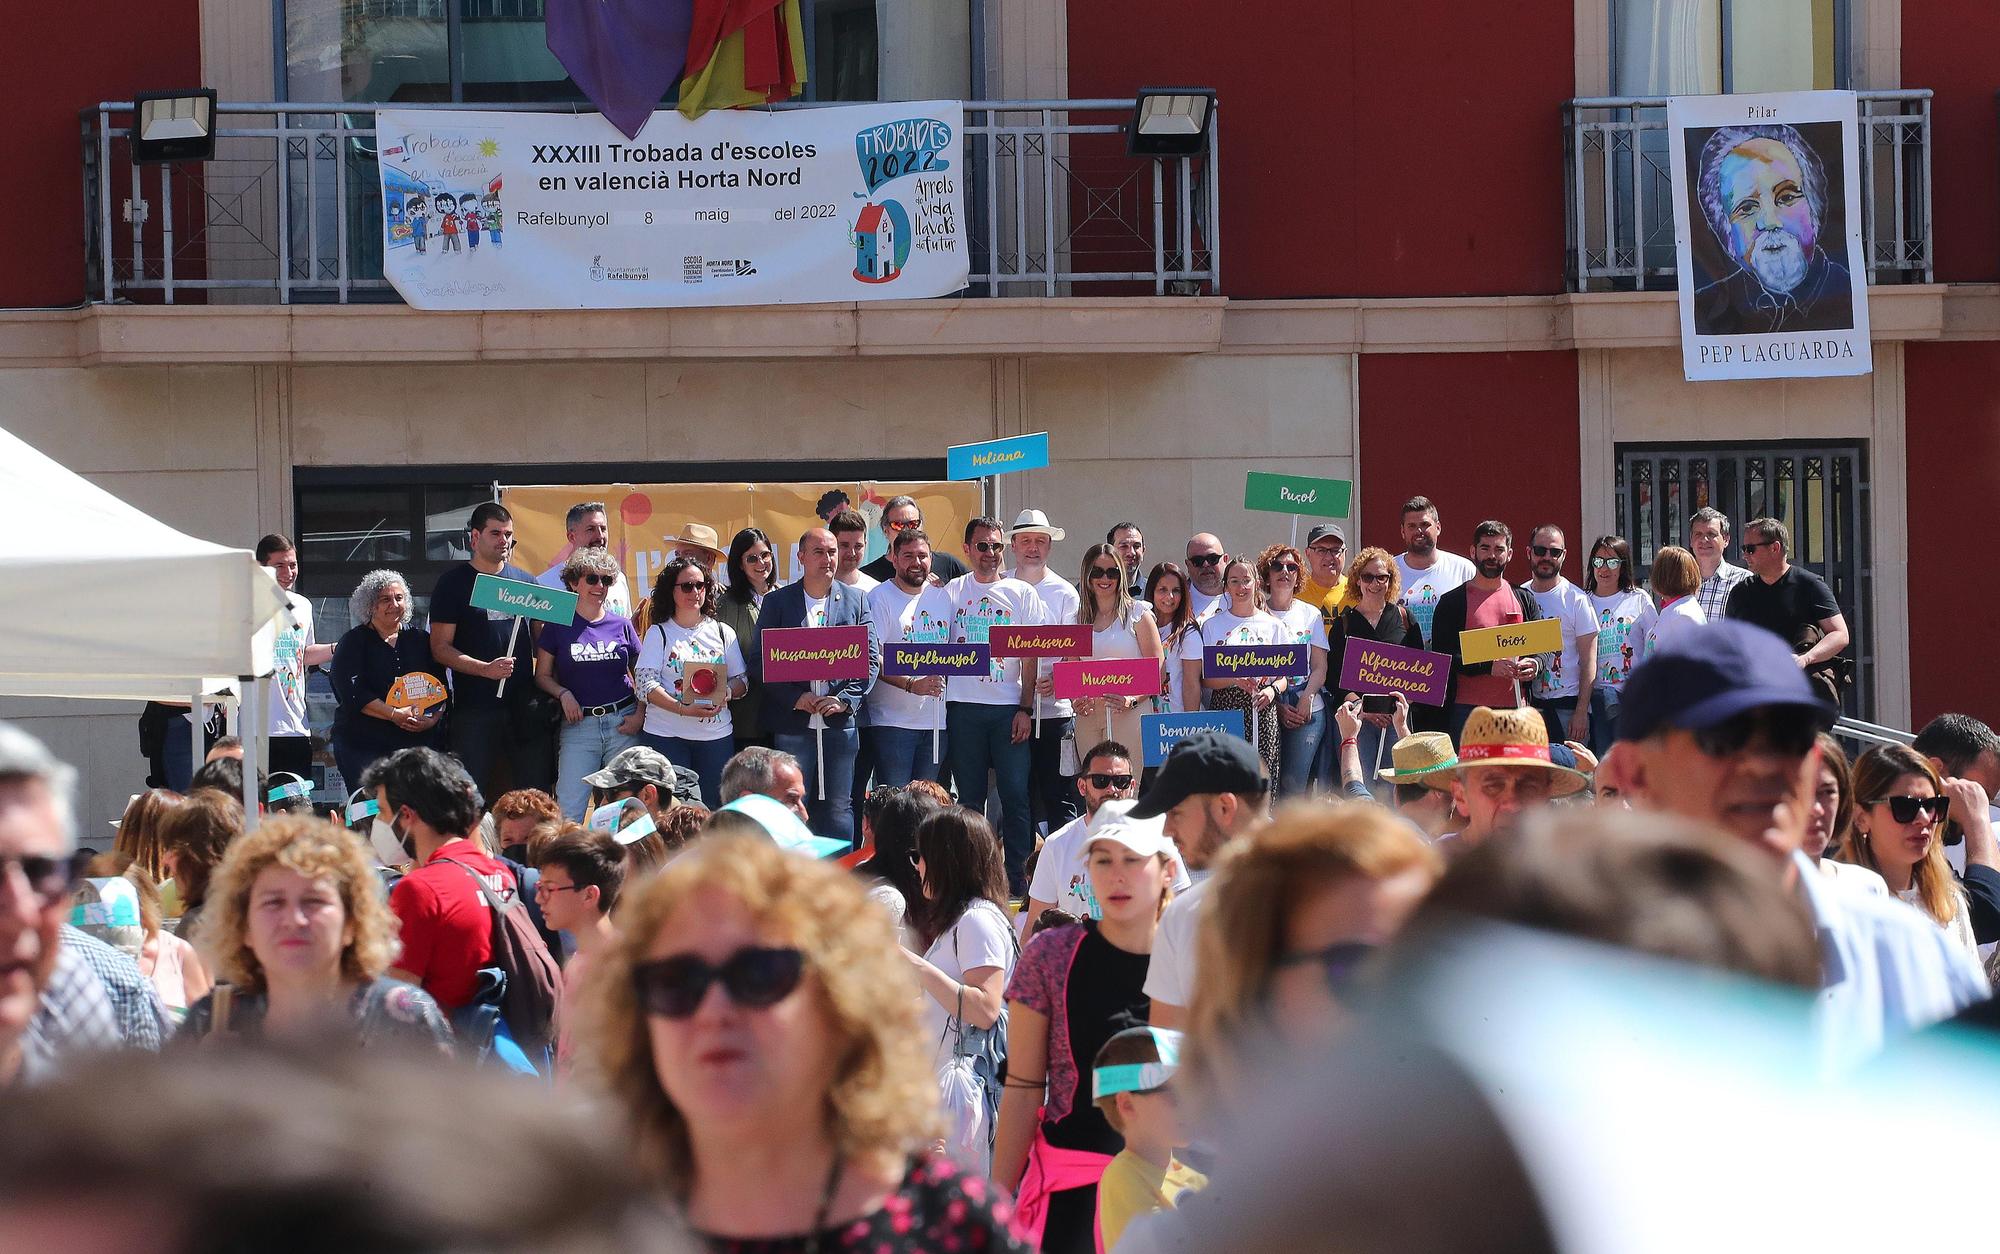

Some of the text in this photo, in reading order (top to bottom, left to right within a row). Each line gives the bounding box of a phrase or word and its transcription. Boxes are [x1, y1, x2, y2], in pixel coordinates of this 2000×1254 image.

[1747, 106, 1777, 118] Pilar
[858, 120, 949, 155] TROBADES
[532, 141, 817, 164] XXXIII Trobada d'escoles
[539, 167, 801, 191] en valencià Horta Nord
[867, 151, 935, 188] 2022
[915, 175, 954, 201] Arrels
[517, 204, 837, 228] Rafelbunyol 8 maig del 2022
[915, 213, 956, 236] llavors
[924, 236, 957, 253] futur
[607, 272, 649, 280] Rafelbunyol
[1700, 340, 1855, 363] PEP LAGUARDA
[972, 450, 1025, 467] Meliana
[1279, 486, 1318, 507] Puçol
[498, 587, 554, 611] Vinalesa
[1007, 634, 1076, 650] Almàssera
[1496, 633, 1528, 648] Foios
[770, 643, 862, 666] Massamagrell
[896, 650, 978, 670] Rafelbunyol
[1216, 651, 1296, 671] Rafelbunyol
[1360, 650, 1435, 677] Alfara del
[1081, 671, 1134, 686] Museros
[1358, 668, 1431, 693] Patriarca
